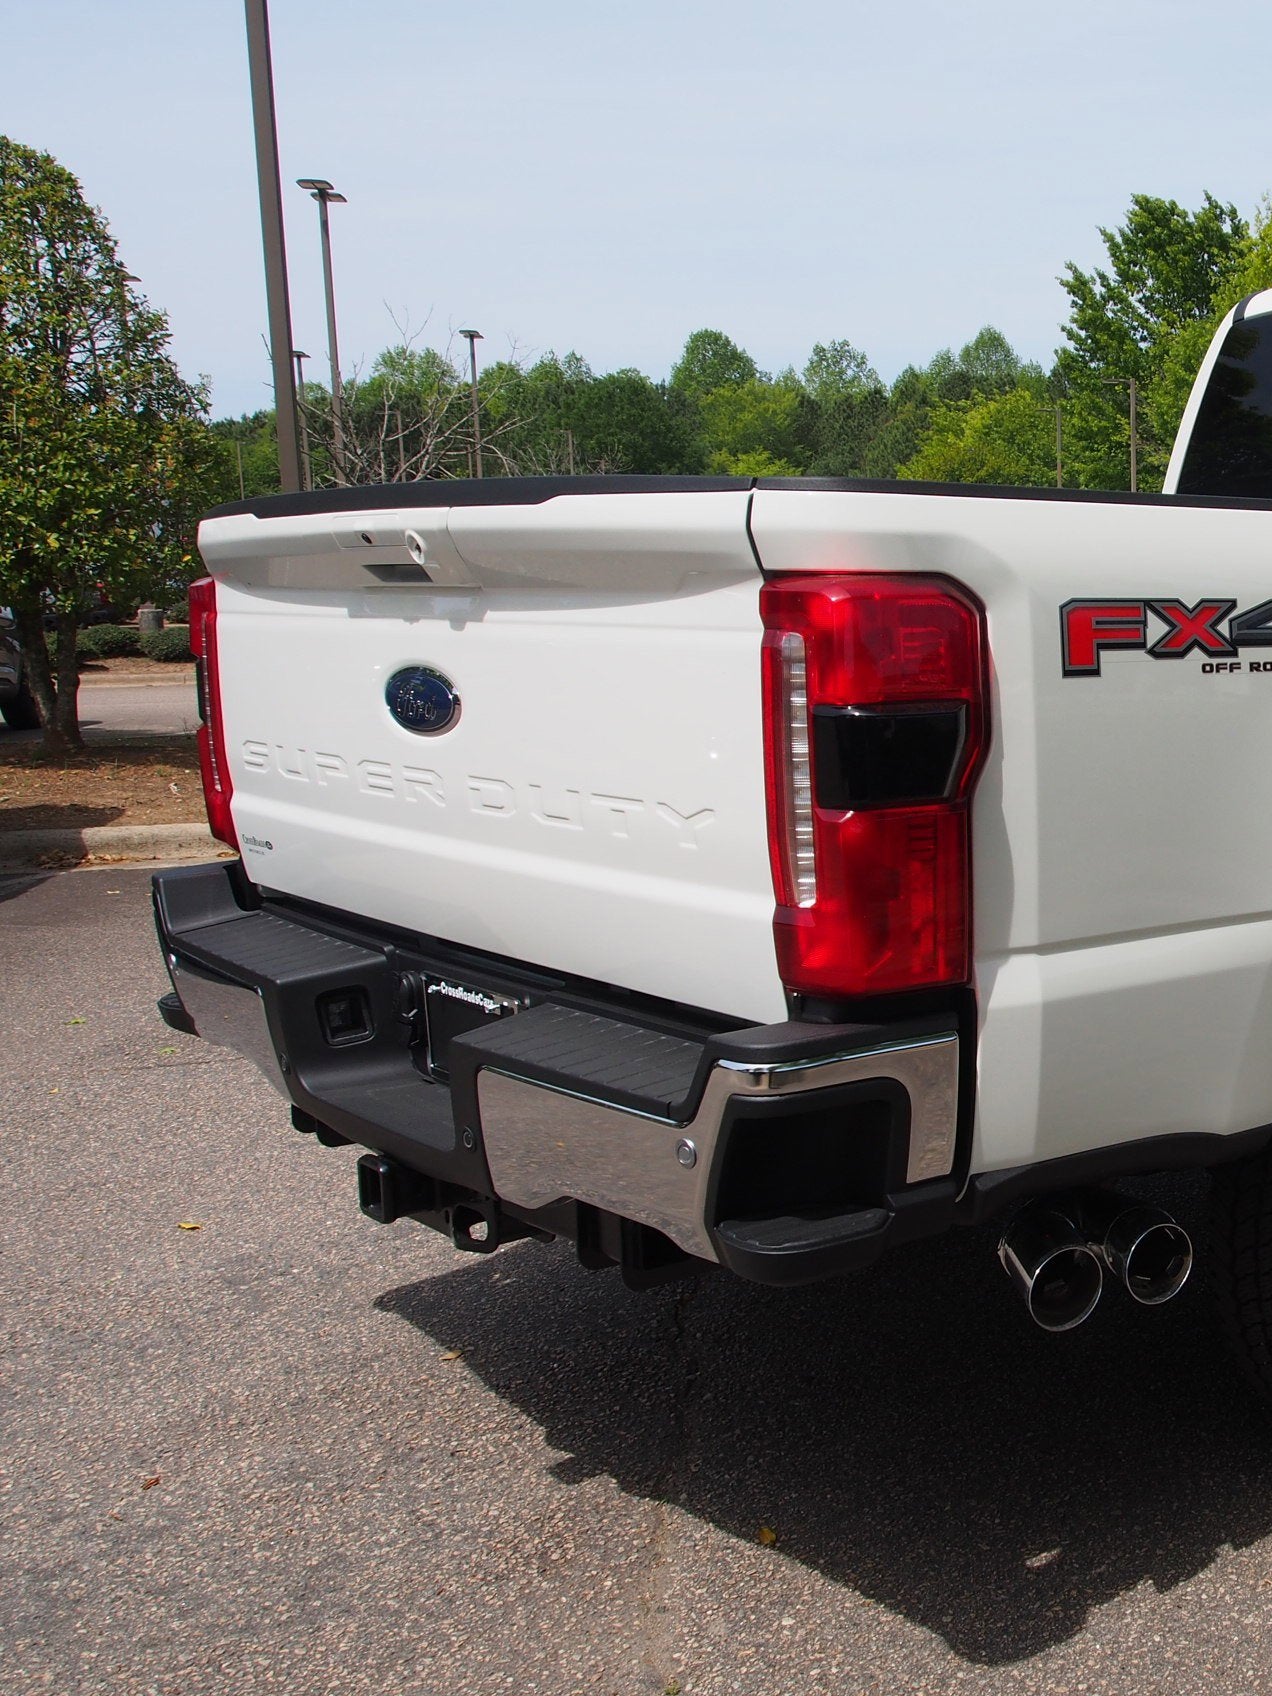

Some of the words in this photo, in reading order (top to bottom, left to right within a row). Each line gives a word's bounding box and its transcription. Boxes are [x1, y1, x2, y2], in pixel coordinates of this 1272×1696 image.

[1201, 662, 1242, 674] OFF
[396, 682, 437, 720] Ford
[242, 739, 446, 807] SUPER
[467, 774, 716, 850] DUTY
